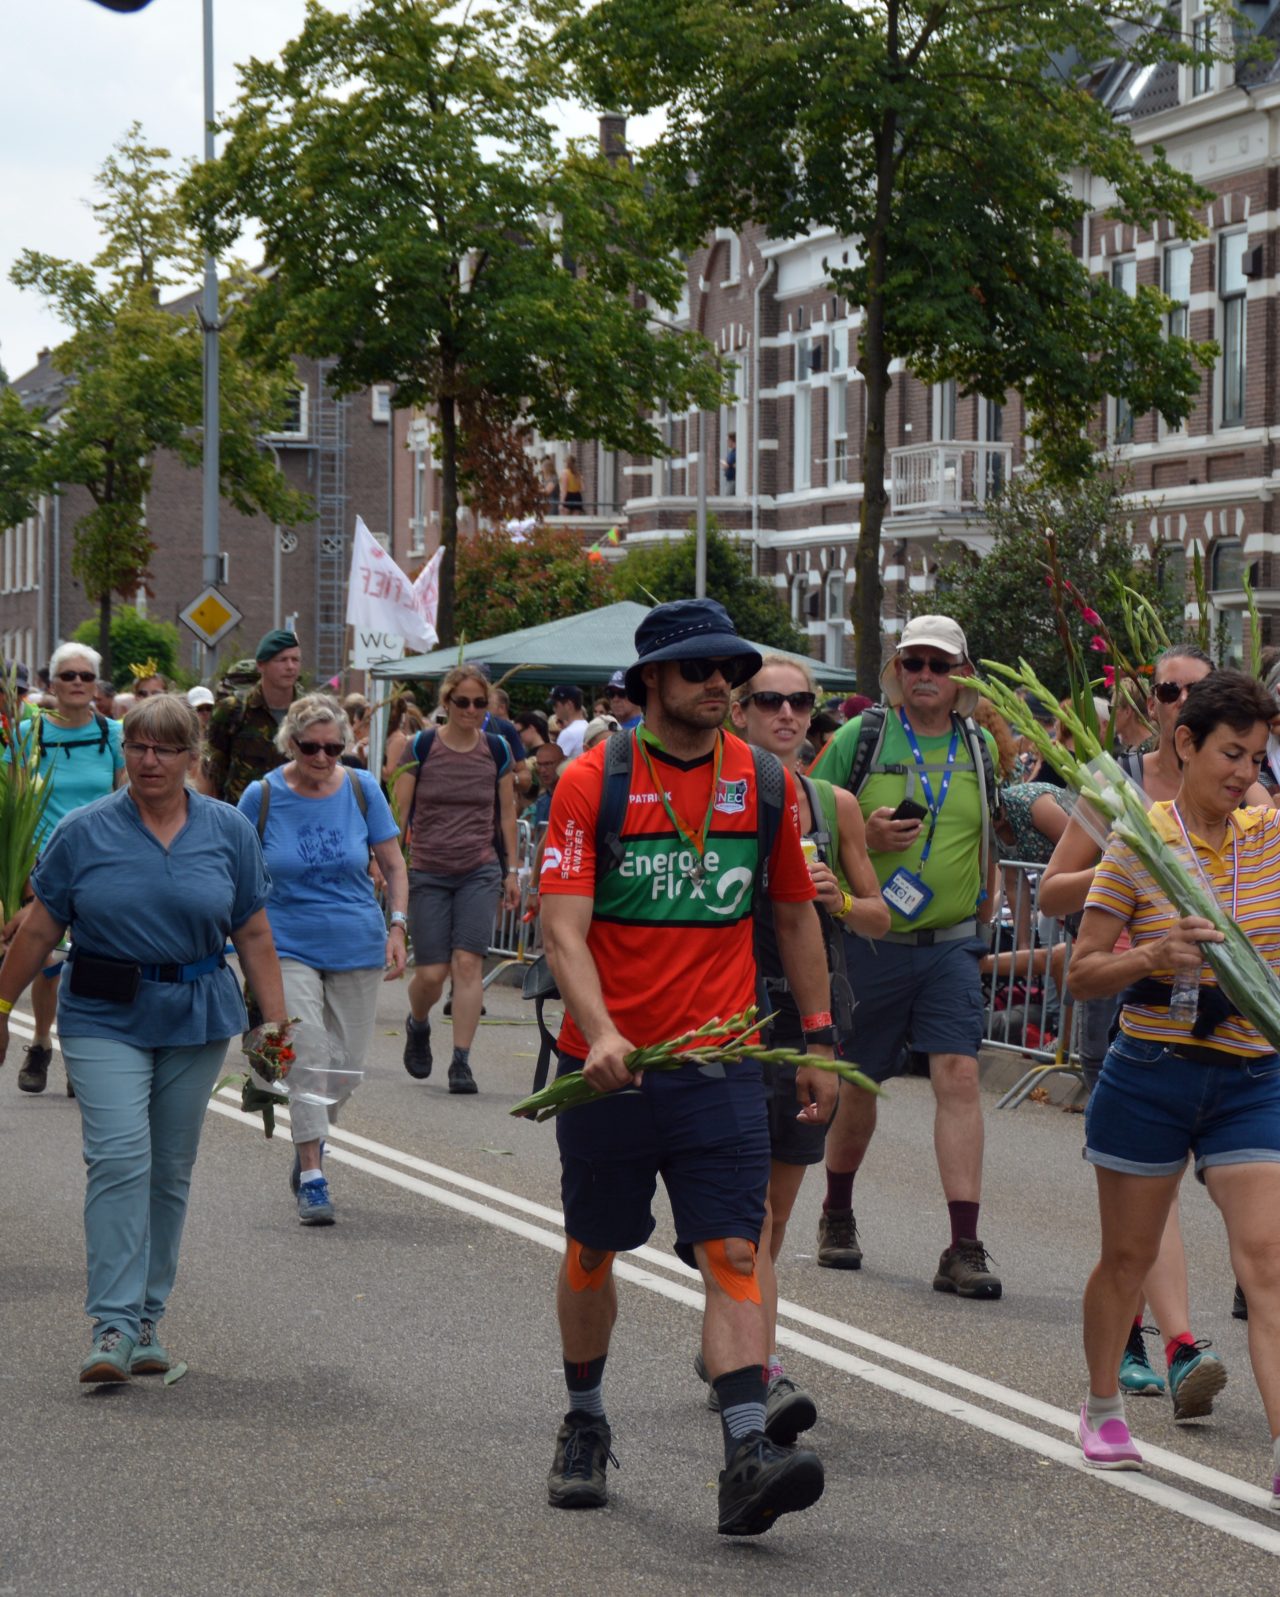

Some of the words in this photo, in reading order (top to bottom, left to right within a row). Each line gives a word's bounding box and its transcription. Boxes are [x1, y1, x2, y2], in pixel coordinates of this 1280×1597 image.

[360, 632, 397, 649] WC
[629, 791, 672, 804] PATRIK
[718, 793, 743, 803] NEC
[561, 819, 576, 879] SCHOLTEN
[572, 829, 584, 873] AWATER
[618, 850, 720, 878] Energe
